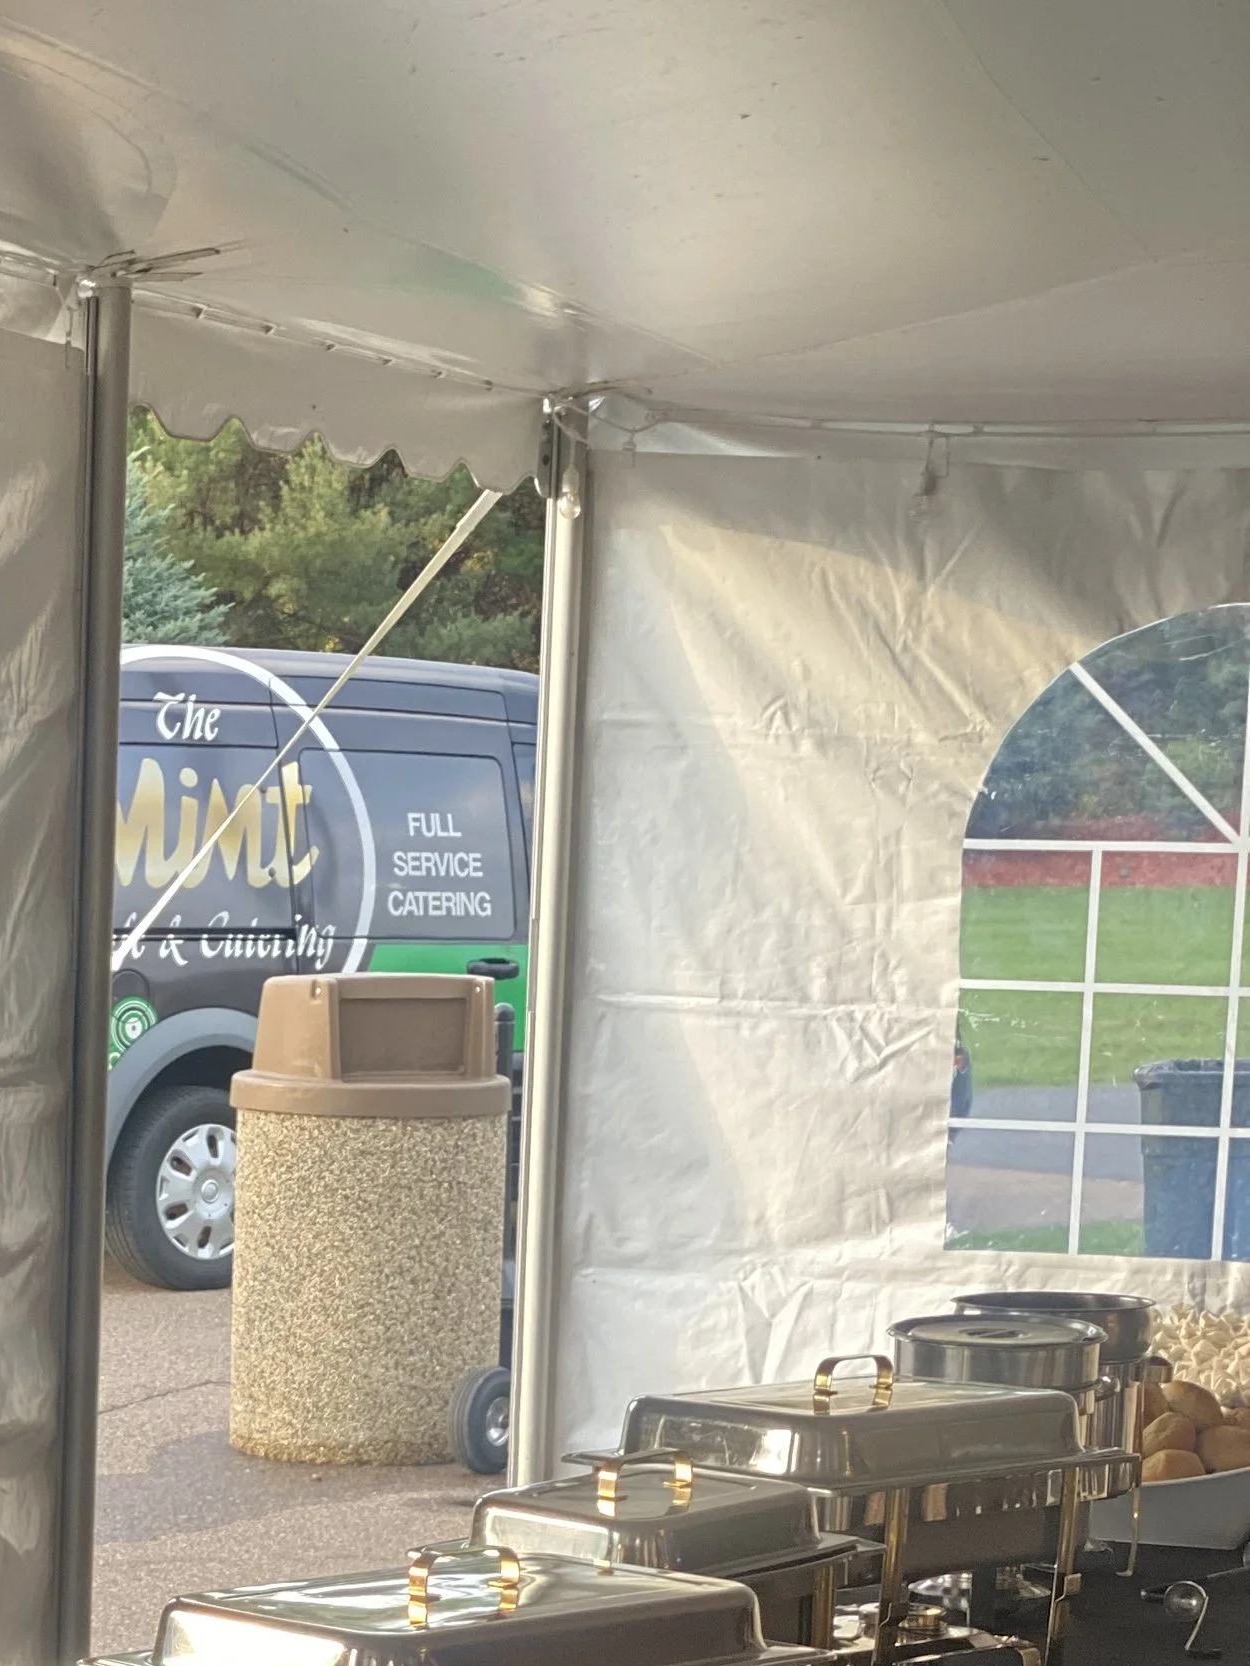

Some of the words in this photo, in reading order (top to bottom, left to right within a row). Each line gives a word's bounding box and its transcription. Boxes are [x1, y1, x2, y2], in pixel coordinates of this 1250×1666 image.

[153, 691, 222, 742] The
[407, 812, 463, 838] FULL
[393, 850, 484, 878] SERVICE
[387, 890, 493, 918] CATERING
[158, 913, 188, 966] &
[200, 910, 337, 971] Catering
